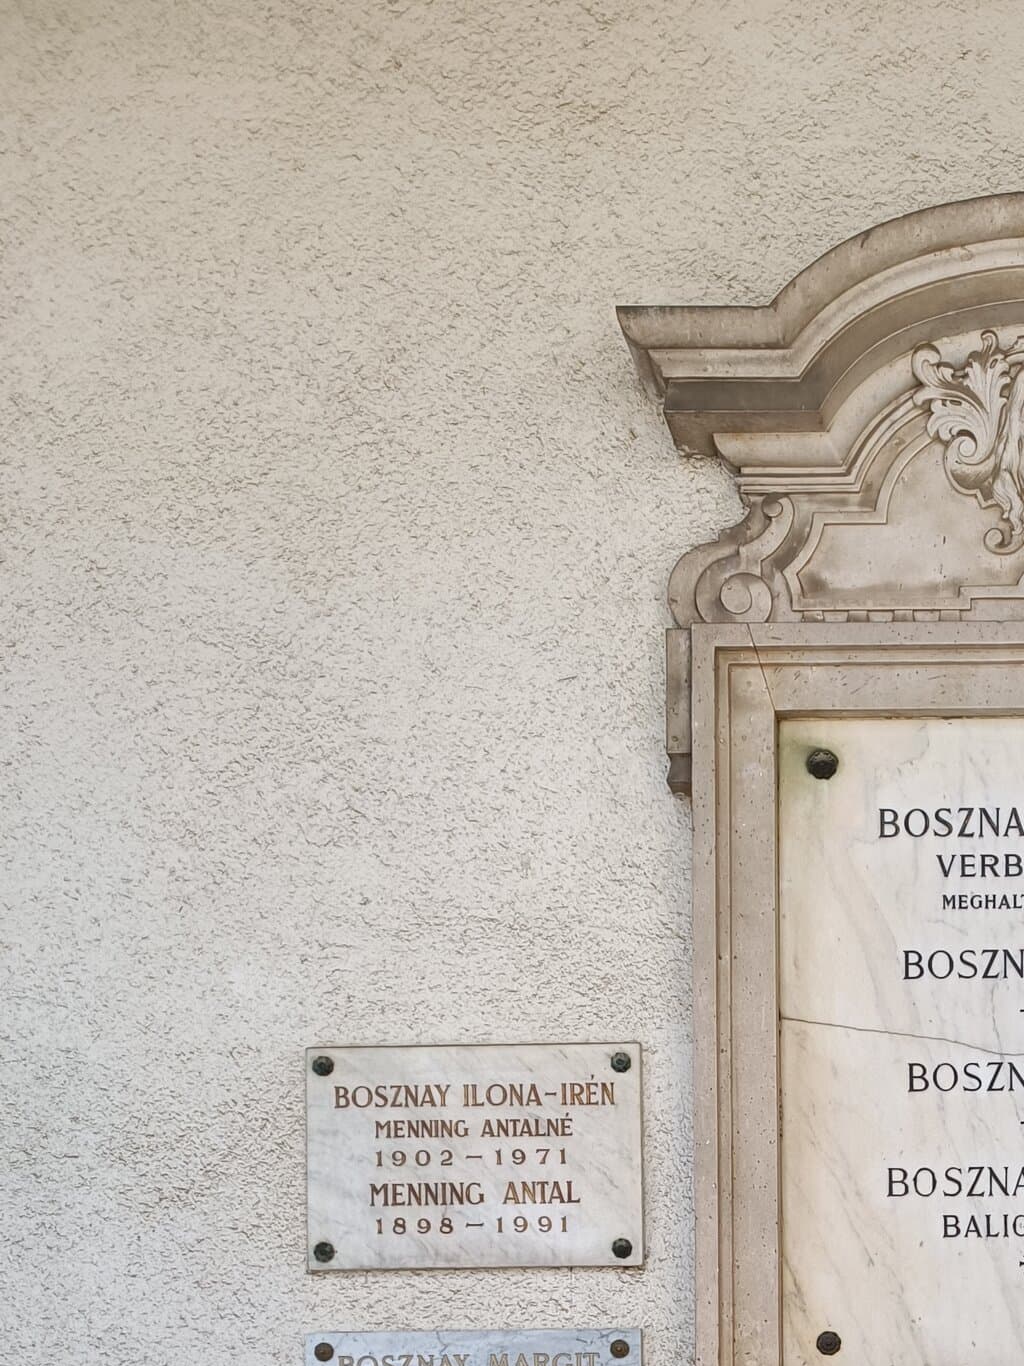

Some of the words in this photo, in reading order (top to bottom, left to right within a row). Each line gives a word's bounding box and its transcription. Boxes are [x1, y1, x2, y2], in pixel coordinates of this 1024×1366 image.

[334, 1084, 450, 1108] BOSZNAY
[375, 1120, 469, 1139] MENNING
[481, 1113, 573, 1137] ANTALNÉ
[376, 1150, 454, 1167] 1902
[496, 1148, 568, 1165] 1971
[370, 1183, 484, 1207] MENNING
[503, 1181, 581, 1204] ANTAL
[376, 1217, 454, 1234] 1898
[497, 1216, 568, 1234] 1991
